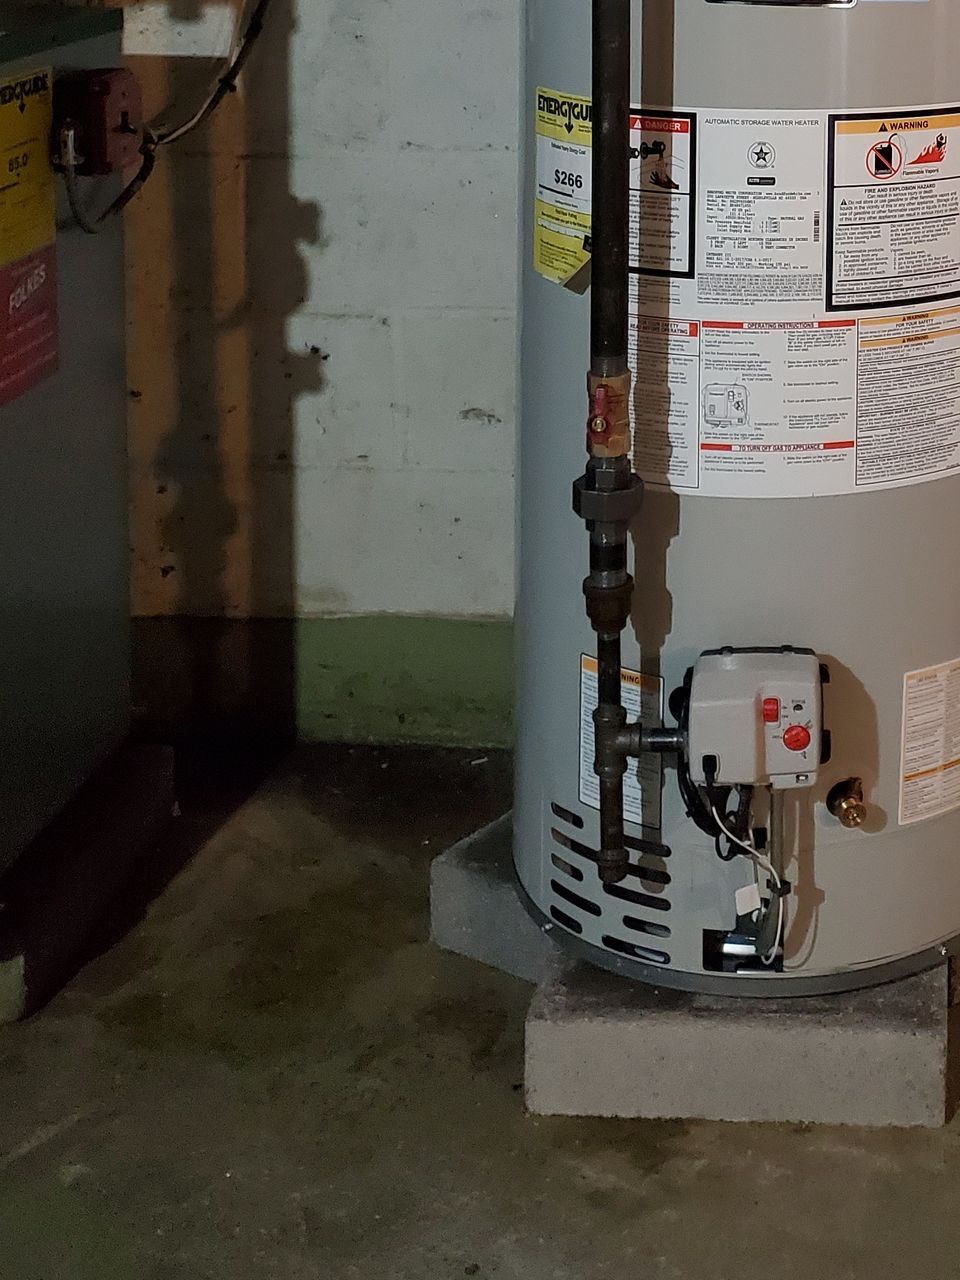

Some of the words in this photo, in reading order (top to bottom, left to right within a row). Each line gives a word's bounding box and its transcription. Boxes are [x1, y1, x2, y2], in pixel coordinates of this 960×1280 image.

[538, 94, 592, 122] ENERGYGUI
[646, 120, 681, 132] DANGER
[890, 120, 928, 130] WARNING
[554, 168, 582, 188] $266
[661, 326, 688, 334] OPERATING
[621, 674, 640, 684] NING
